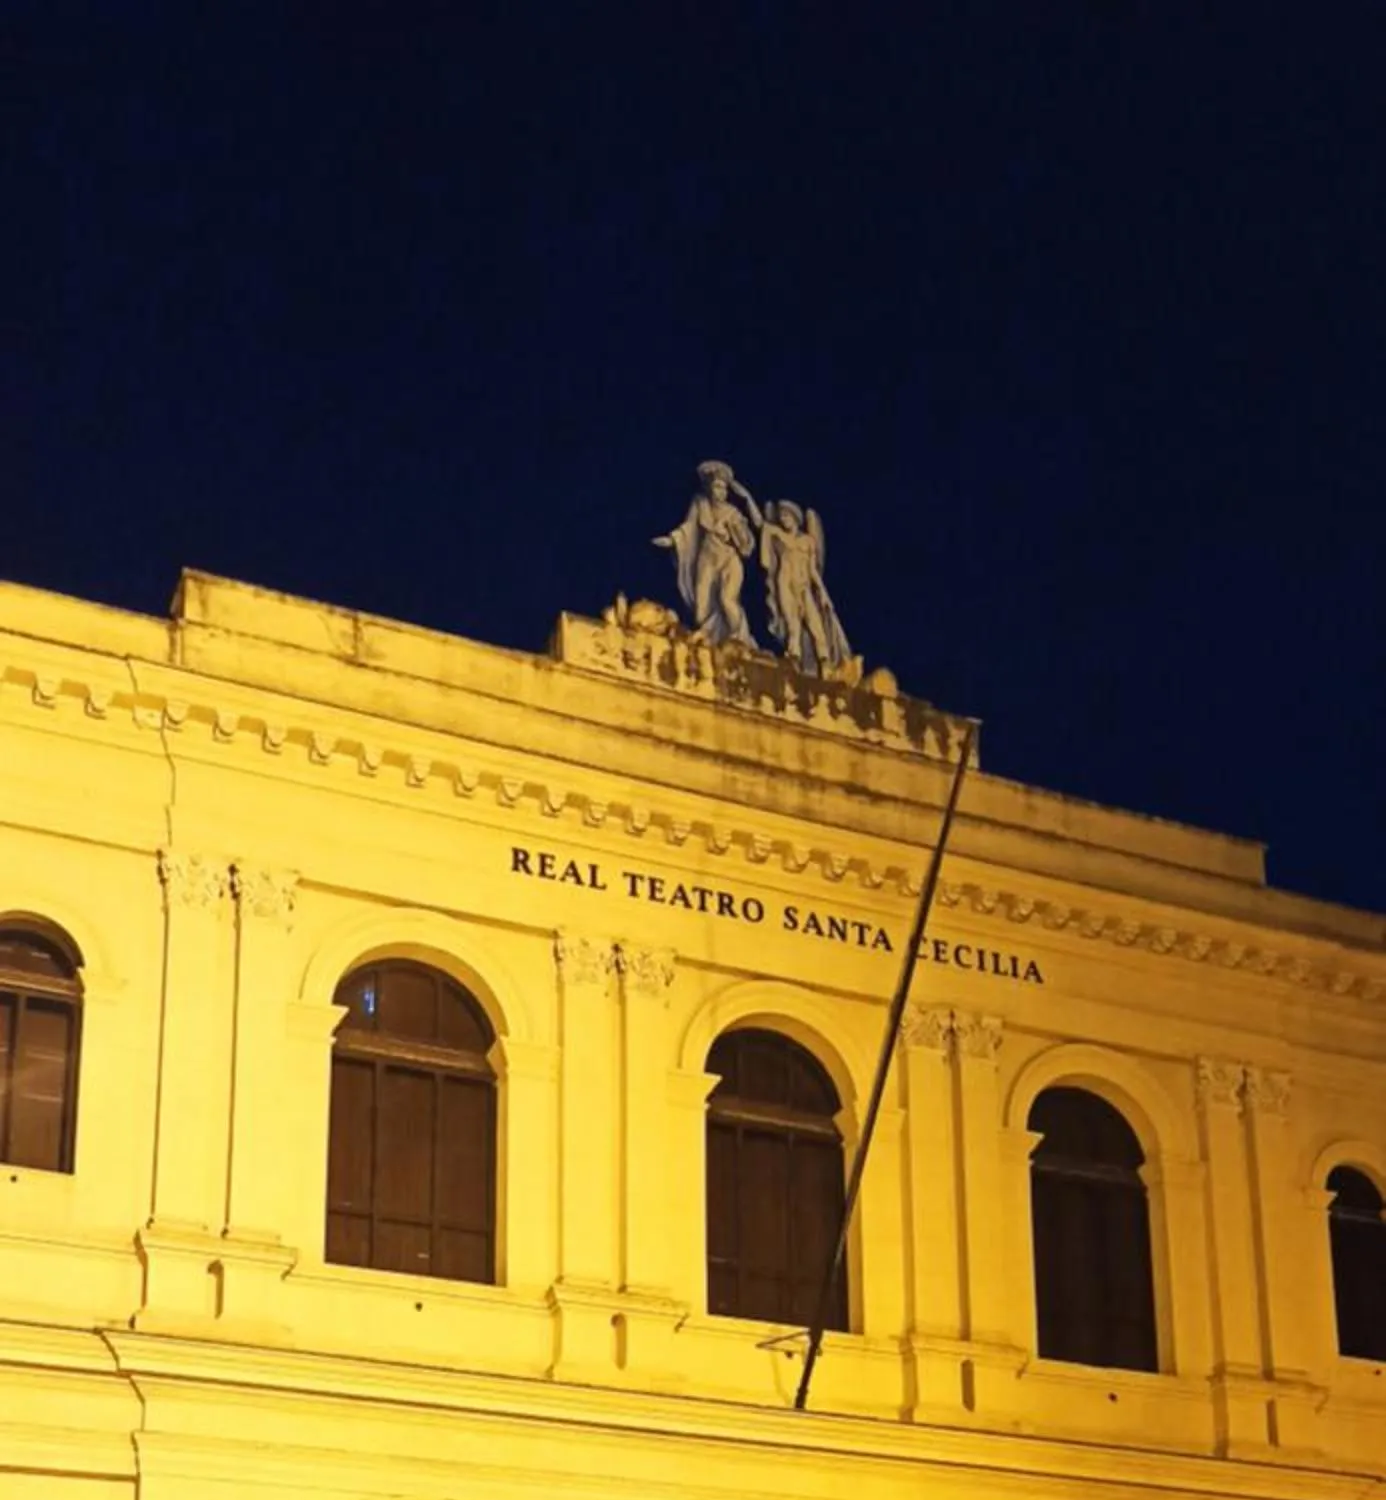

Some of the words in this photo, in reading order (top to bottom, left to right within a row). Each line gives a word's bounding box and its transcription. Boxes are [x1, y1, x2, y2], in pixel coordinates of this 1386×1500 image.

[510, 847, 607, 890] REAL
[622, 872, 764, 923] TEATRO
[783, 906, 893, 952] SANTA
